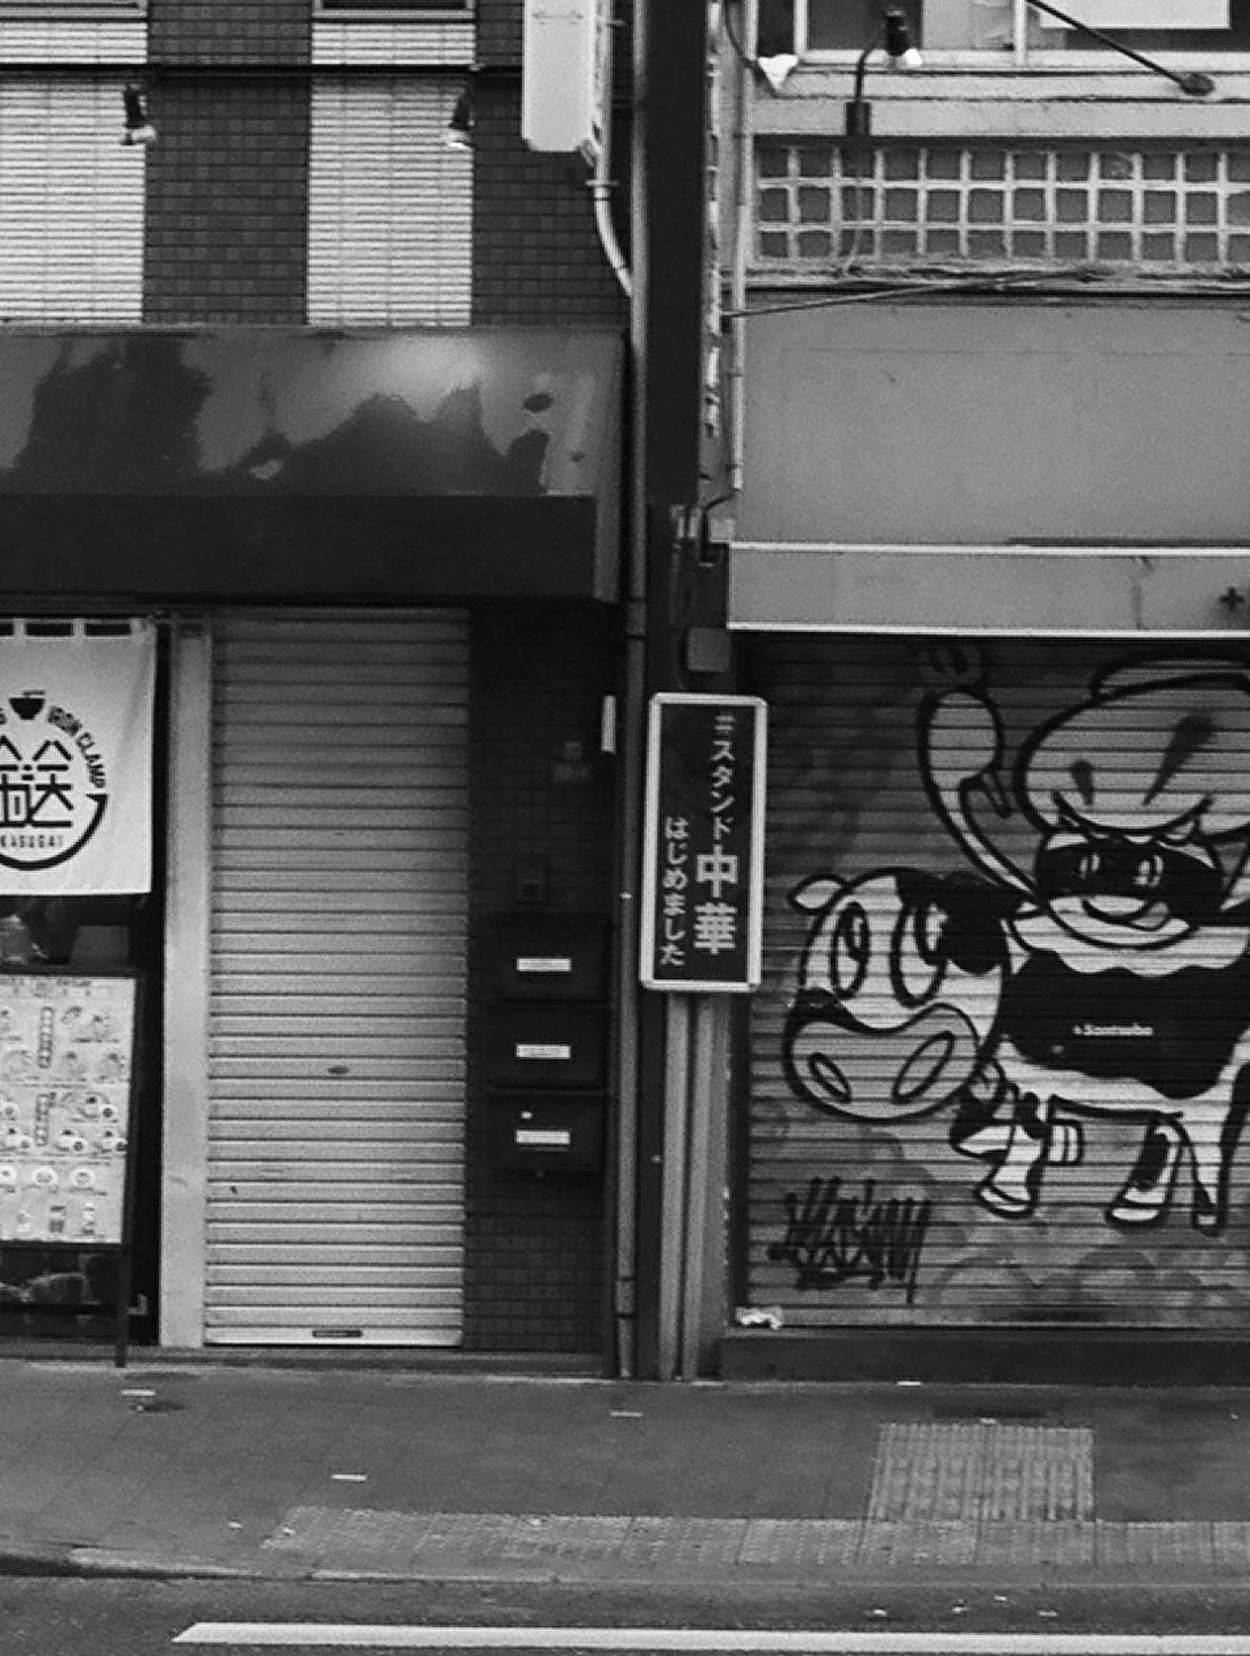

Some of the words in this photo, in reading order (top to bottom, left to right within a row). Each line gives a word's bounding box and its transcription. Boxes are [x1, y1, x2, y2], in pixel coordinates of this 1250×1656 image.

[660, 816, 690, 966] はじめました
